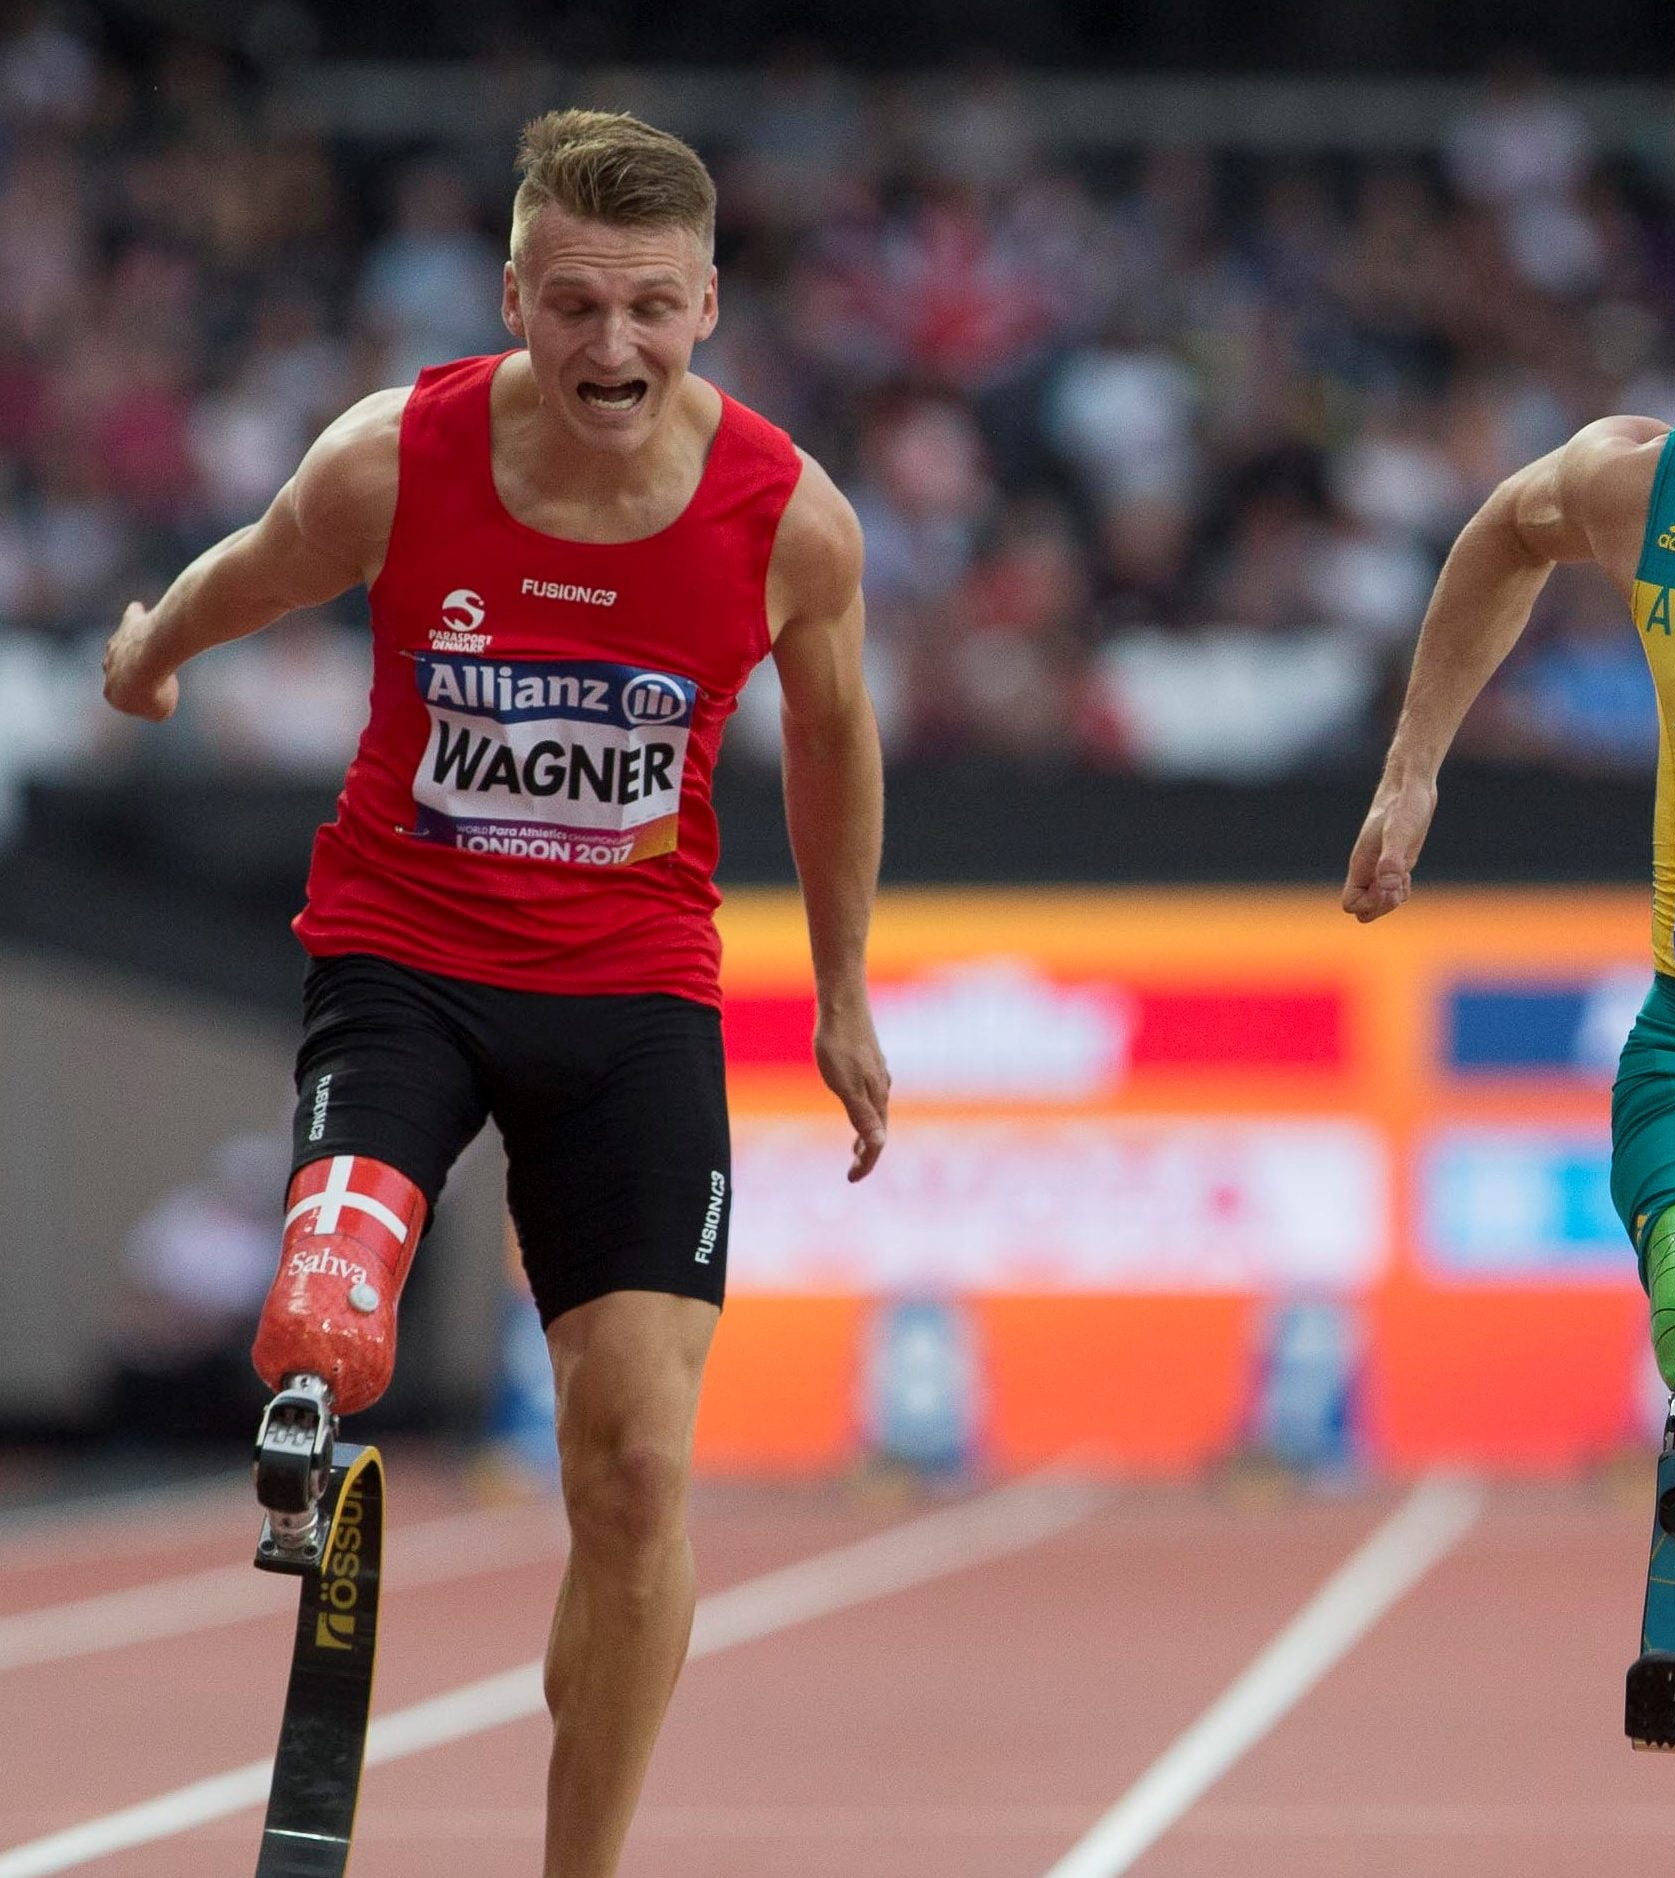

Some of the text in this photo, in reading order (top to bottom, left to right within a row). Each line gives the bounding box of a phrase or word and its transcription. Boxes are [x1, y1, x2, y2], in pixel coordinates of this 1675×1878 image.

[428, 629, 493, 646] PARASPORT
[431, 638, 485, 653] DENMARK
[427, 662, 610, 711] Allianz
[431, 719, 676, 805] WAGNER
[489, 825, 518, 837] Para
[518, 826, 568, 841] Athletics
[456, 834, 634, 866] LONDON 2017
[287, 1247, 368, 1285] Sahva
